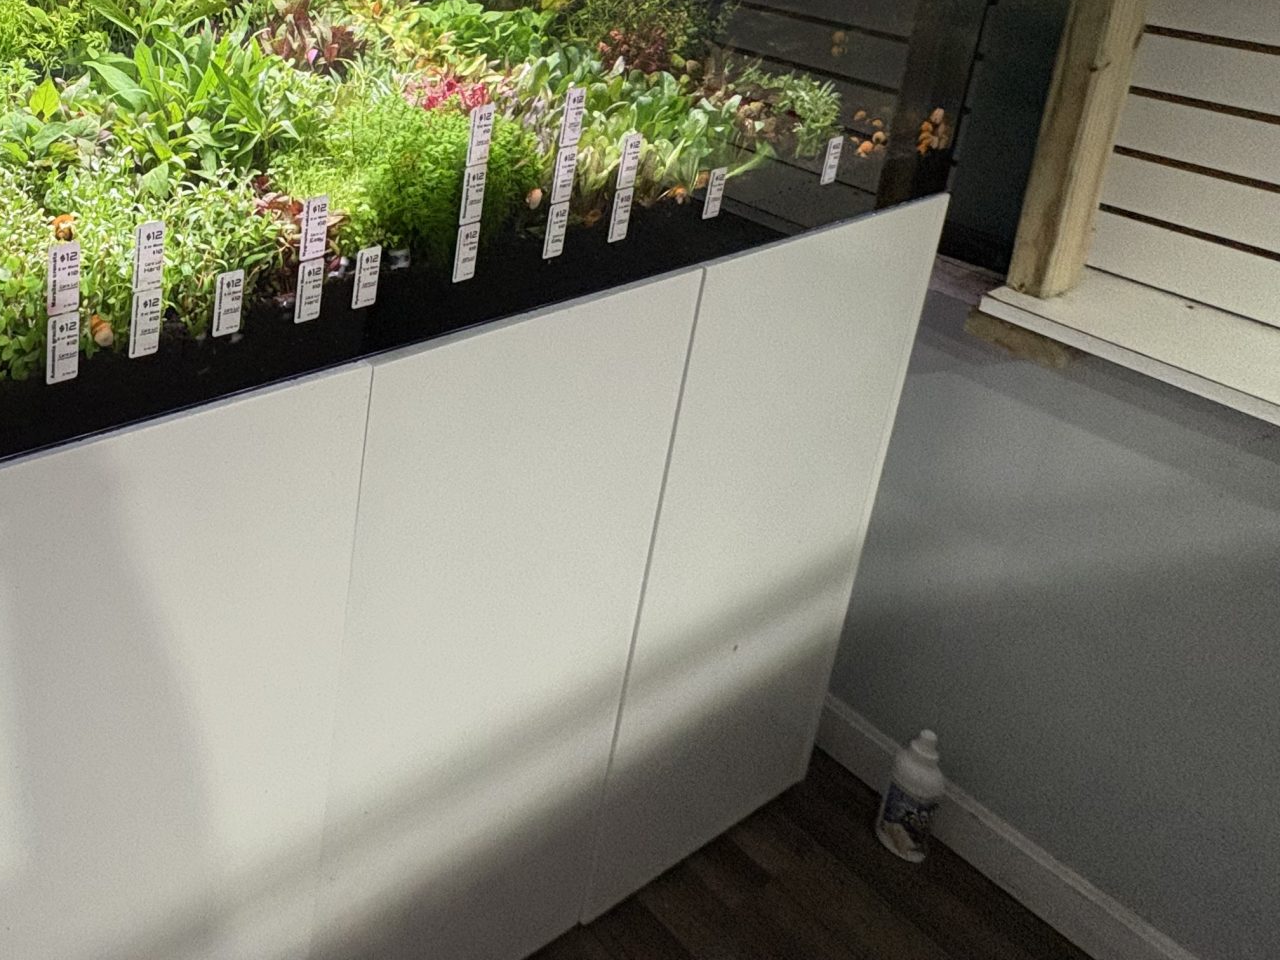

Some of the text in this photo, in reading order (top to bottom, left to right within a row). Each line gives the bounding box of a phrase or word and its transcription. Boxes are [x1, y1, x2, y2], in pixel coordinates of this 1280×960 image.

[146, 231, 163, 241] $12
[60, 251, 77, 262] $12
[144, 299, 160, 309] $12
[59, 321, 76, 333] $12
